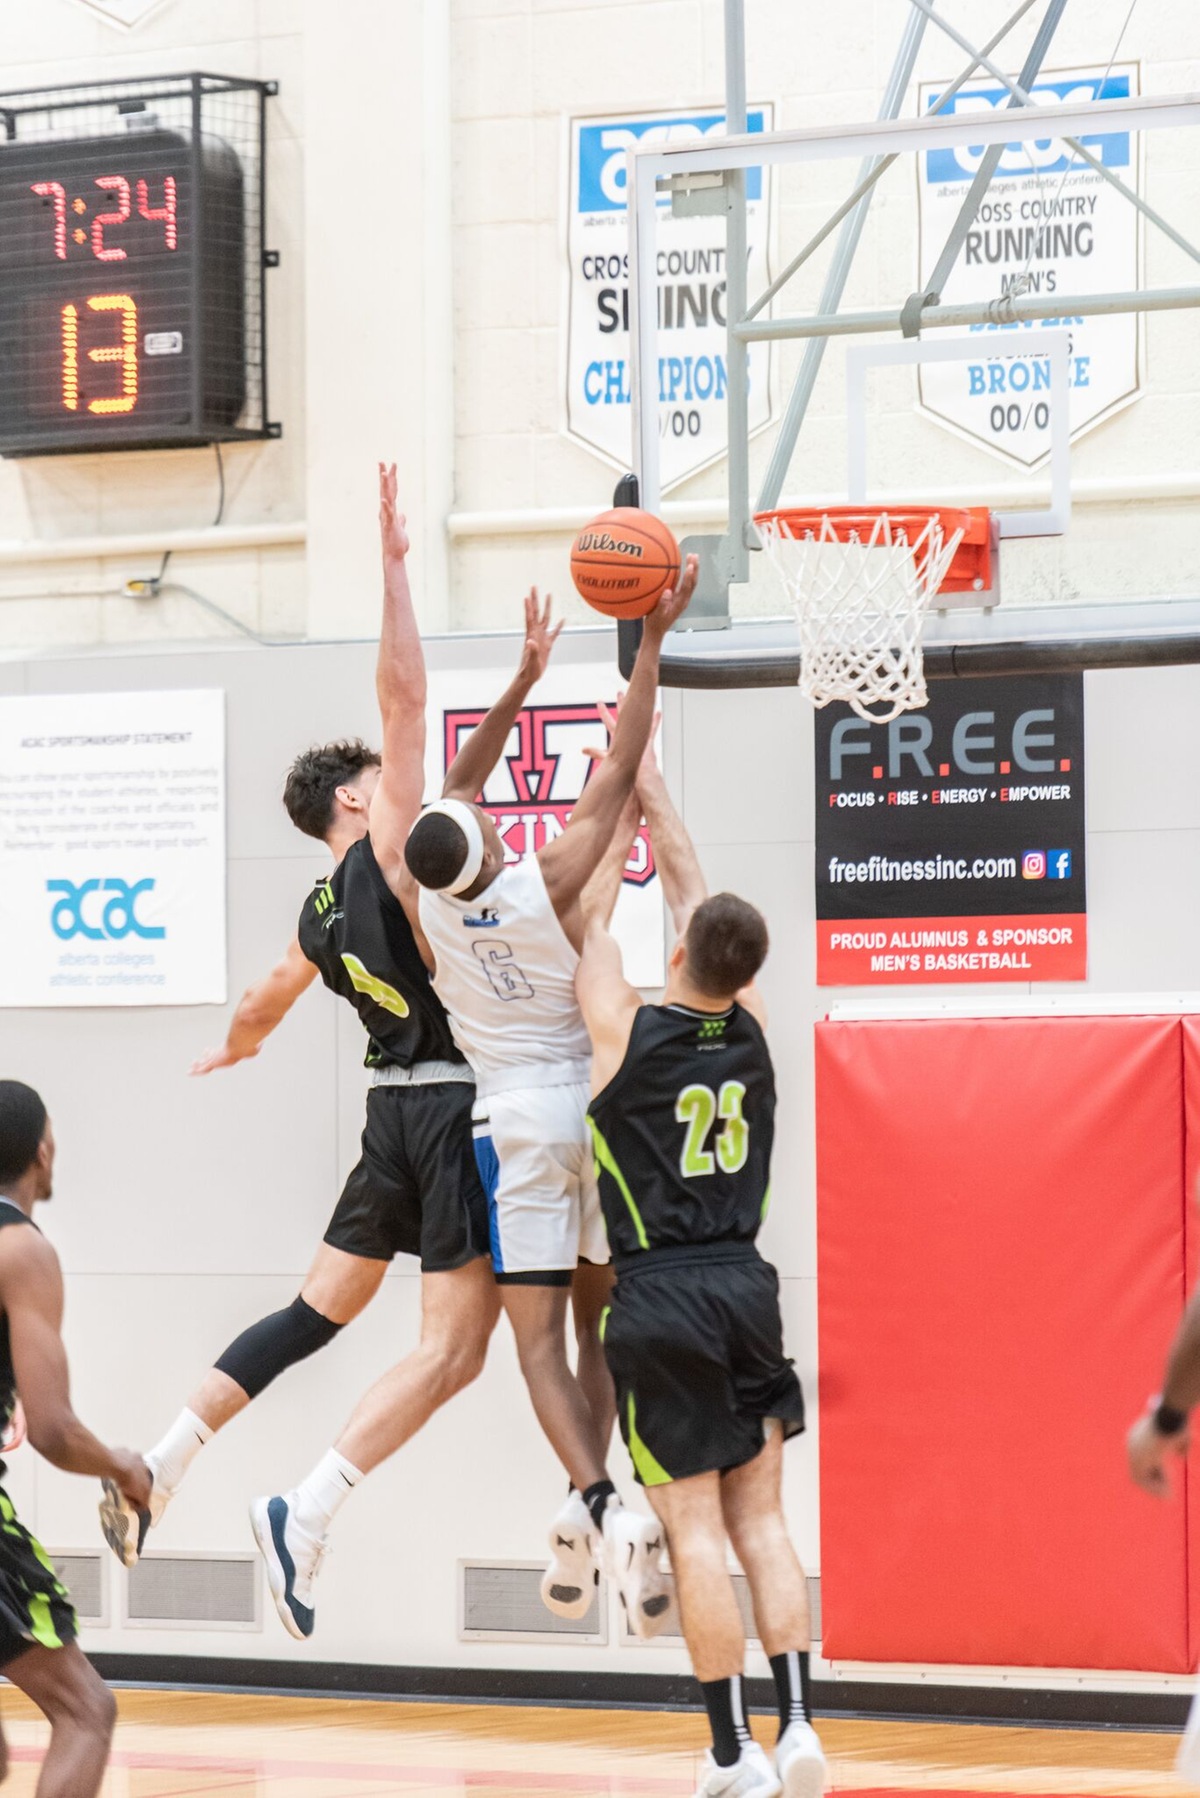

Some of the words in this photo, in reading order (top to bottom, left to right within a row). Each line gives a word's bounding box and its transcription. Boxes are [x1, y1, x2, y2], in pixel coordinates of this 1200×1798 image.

[30, 176, 177, 261] 7:24
[1021, 195, 1097, 220] COUNTRY
[966, 222, 1093, 265] RUNNING
[62, 294, 138, 414] 13
[990, 401, 1049, 432] 00/0
[578, 533, 643, 558] Wilson
[132, 732, 192, 745] STATEMENT
[829, 791, 875, 807] FOCUS
[887, 790, 918, 806] RISE
[931, 787, 987, 804] ENERGY
[1000, 785, 1071, 802] EMPOWER
[828, 854, 1016, 883] freefitnessinc.com
[830, 931, 887, 949] PROUD
[890, 929, 968, 949] ALUMNUS
[977, 930, 988, 947] &
[992, 928, 1073, 946] SPONSOR
[58, 952, 100, 966] alberta
[103, 951, 155, 969] colleges
[471, 939, 535, 1002] 6
[871, 954, 920, 971] MEN'S
[924, 952, 1031, 970] BASKETBALL
[95, 972, 166, 986] conference
[675, 1080, 749, 1178] 23
